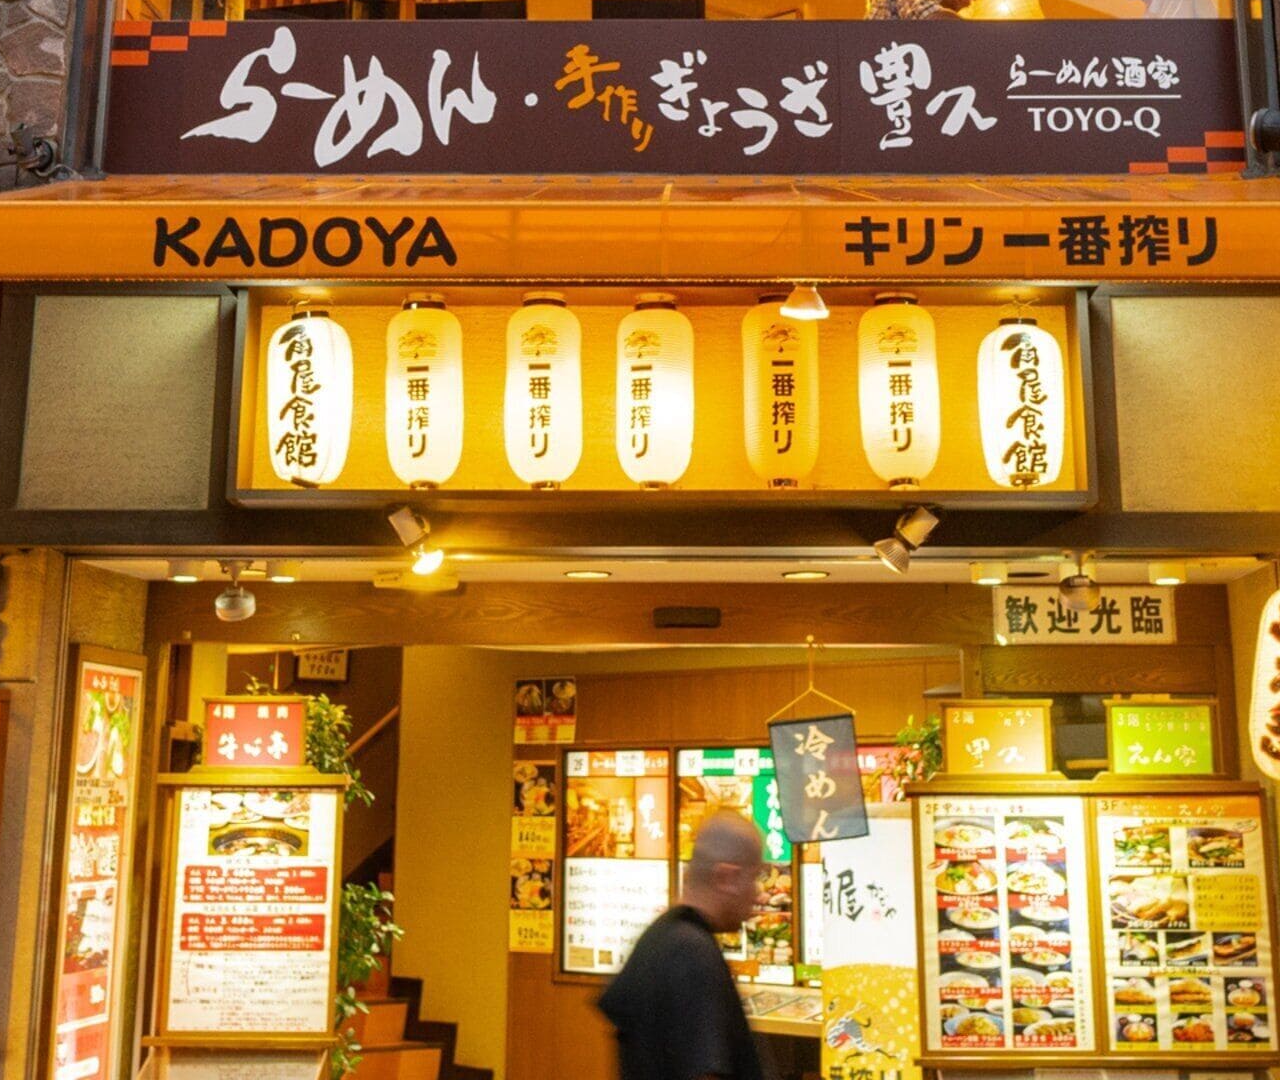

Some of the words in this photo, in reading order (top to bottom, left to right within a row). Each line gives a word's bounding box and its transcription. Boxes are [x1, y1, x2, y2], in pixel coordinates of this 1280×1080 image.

[180, 26, 496, 168] らーめん
[554, 44, 653, 152] 手作り
[650, 49, 833, 156] ぎょうざ
[860, 41, 998, 150] 豊久
[1026, 106, 1162, 137] TOYO-Q
[153, 216, 458, 267] KADOYA
[275, 325, 321, 467] 角屋食館
[406, 364, 432, 458] 一番搾り
[528, 363, 551, 458] 一番搾り
[629, 363, 653, 458] 一番搾り
[770, 358, 796, 454] 一番搾り
[887, 359, 914, 453] 一番搾り
[1002, 331, 1050, 475] 角屋食館
[1117, 711, 1140, 728] 3階
[1127, 742, 1197, 768] えん家
[794, 724, 839, 841] 冷めん
